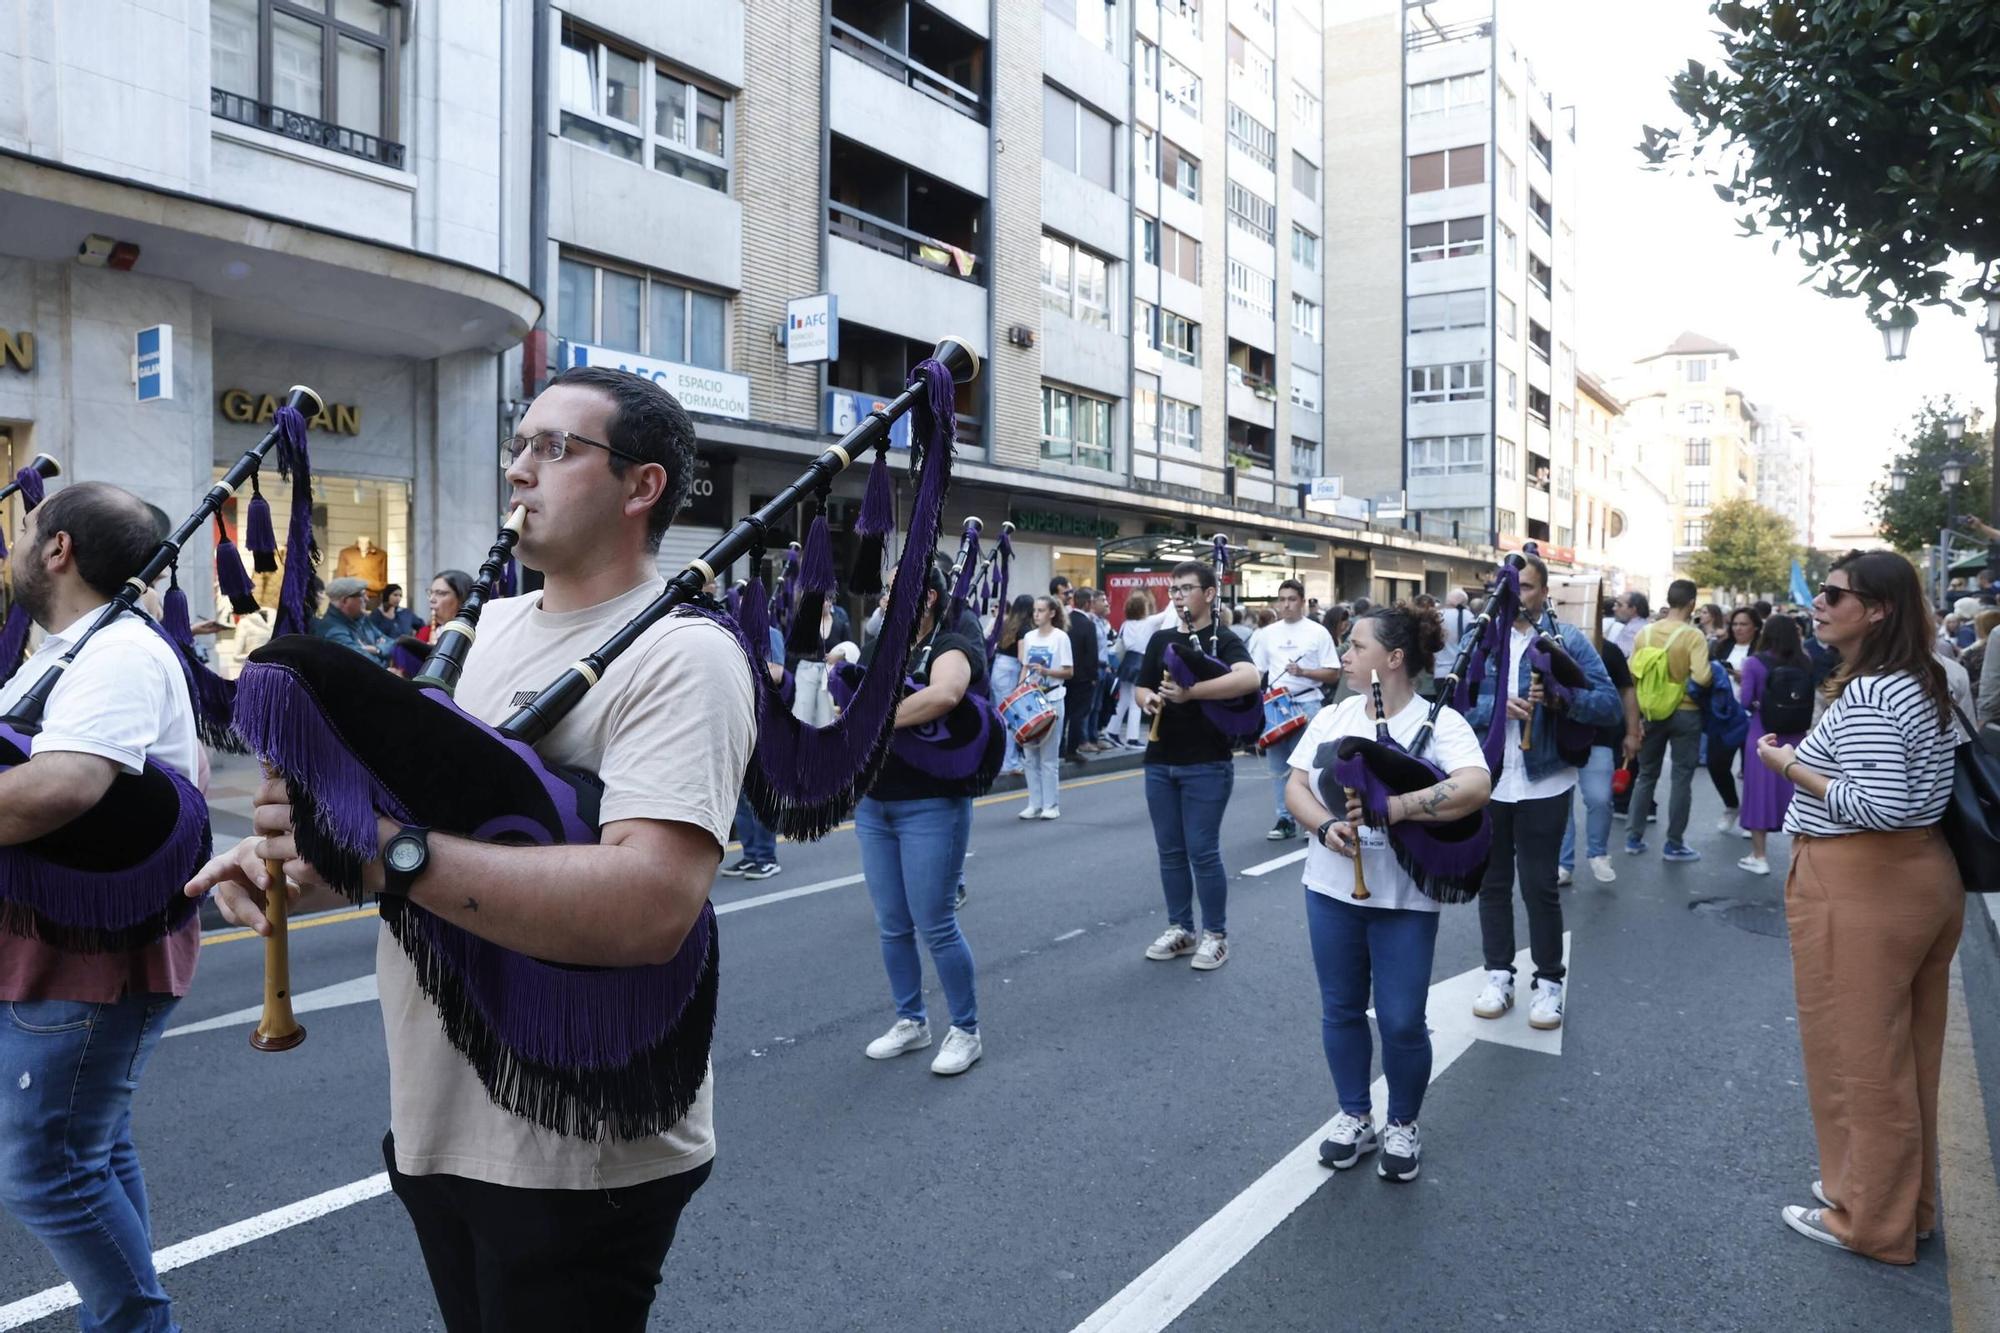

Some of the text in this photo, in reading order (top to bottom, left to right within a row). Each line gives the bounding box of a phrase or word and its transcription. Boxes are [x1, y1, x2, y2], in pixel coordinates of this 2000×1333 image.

[805, 312, 827, 327] AFC
[678, 375, 723, 393] ESPACIO
[678, 391, 745, 414] FORMACIÓN
[223, 388, 361, 436] GAAN
[1109, 576, 1174, 588] GIORGIO ARMAN
[509, 691, 539, 708] PUM
